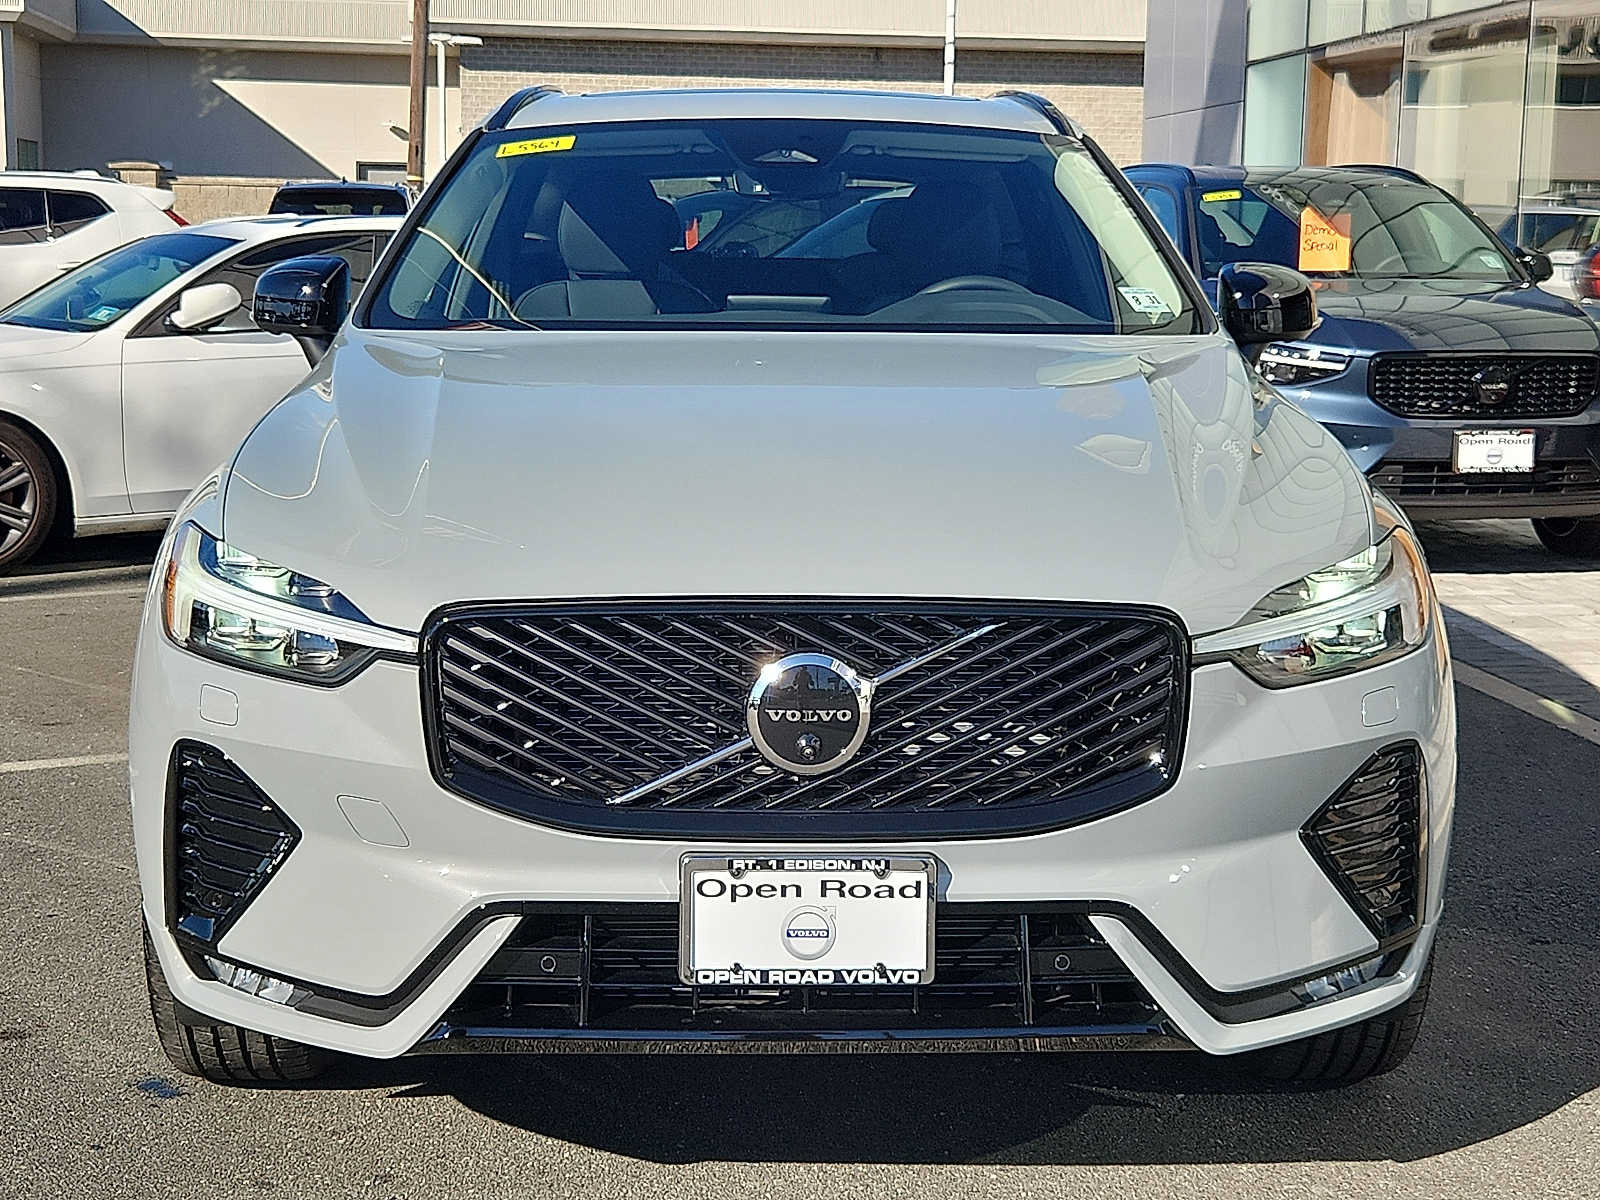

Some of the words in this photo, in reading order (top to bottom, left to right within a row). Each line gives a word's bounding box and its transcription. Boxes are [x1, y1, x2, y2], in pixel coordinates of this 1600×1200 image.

[1304, 223, 1337, 236] Demo
[1459, 437, 1493, 446] Open
[1498, 437, 1531, 445] Road
[764, 709, 852, 722] VOLVO
[768, 859, 778, 870] 1
[861, 859, 887, 870] NJ
[696, 878, 802, 903] Open
[820, 879, 922, 899] Road
[787, 929, 829, 938] VOLVO
[697, 969, 761, 985] OPEN
[768, 969, 835, 985] ROAD
[840, 969, 921, 985] VOLVO
